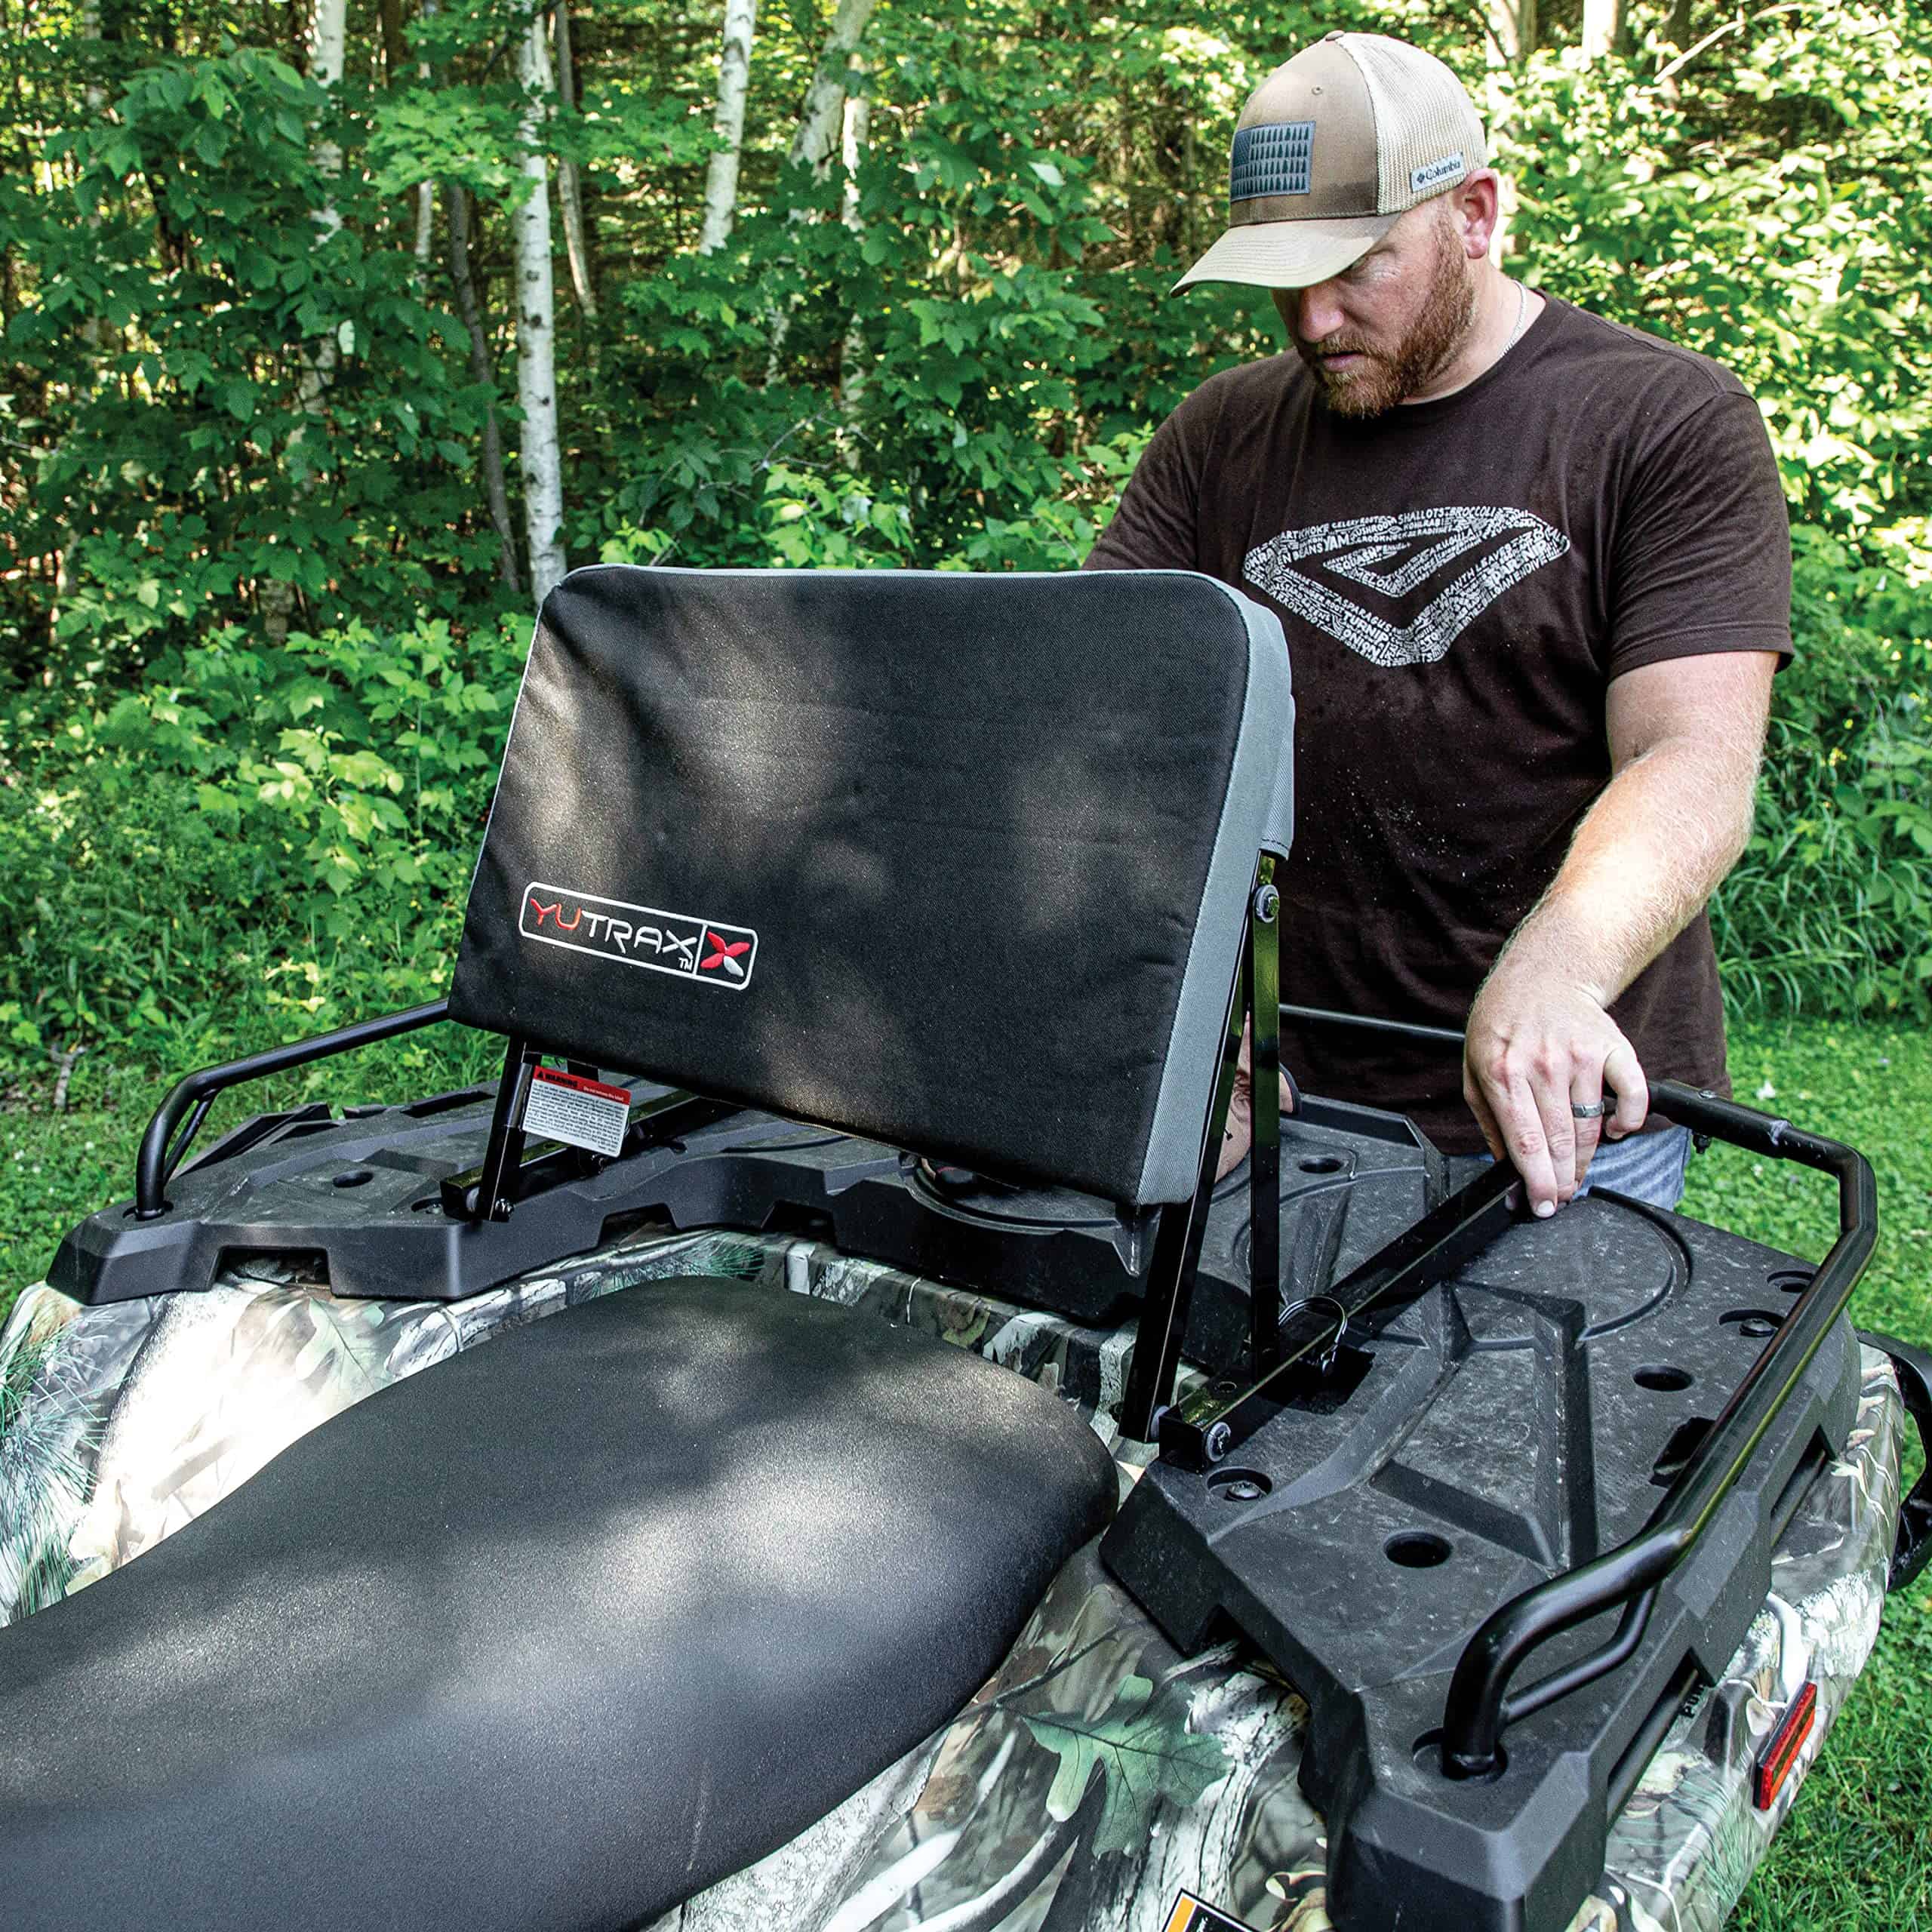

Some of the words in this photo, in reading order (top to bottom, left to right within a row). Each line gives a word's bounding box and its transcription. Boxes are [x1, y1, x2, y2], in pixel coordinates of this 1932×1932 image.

[1425, 159, 1461, 180] Columbia
[1398, 508, 1444, 525] SHALLOTS
[1448, 505, 1497, 518] BROCCOLI
[1292, 543, 1324, 561] BEANS
[1322, 533, 1352, 552] YAM
[1512, 555, 1549, 583] ENDIVE
[1269, 591, 1325, 629] ARROWROOT
[1334, 595, 1392, 632] ASPARAGUS
[1343, 610, 1389, 646] TURNIP
[1343, 628, 1381, 660] ONION
[531, 898, 697, 960] YUTRAX
[545, 1072, 578, 1088] WARNING
